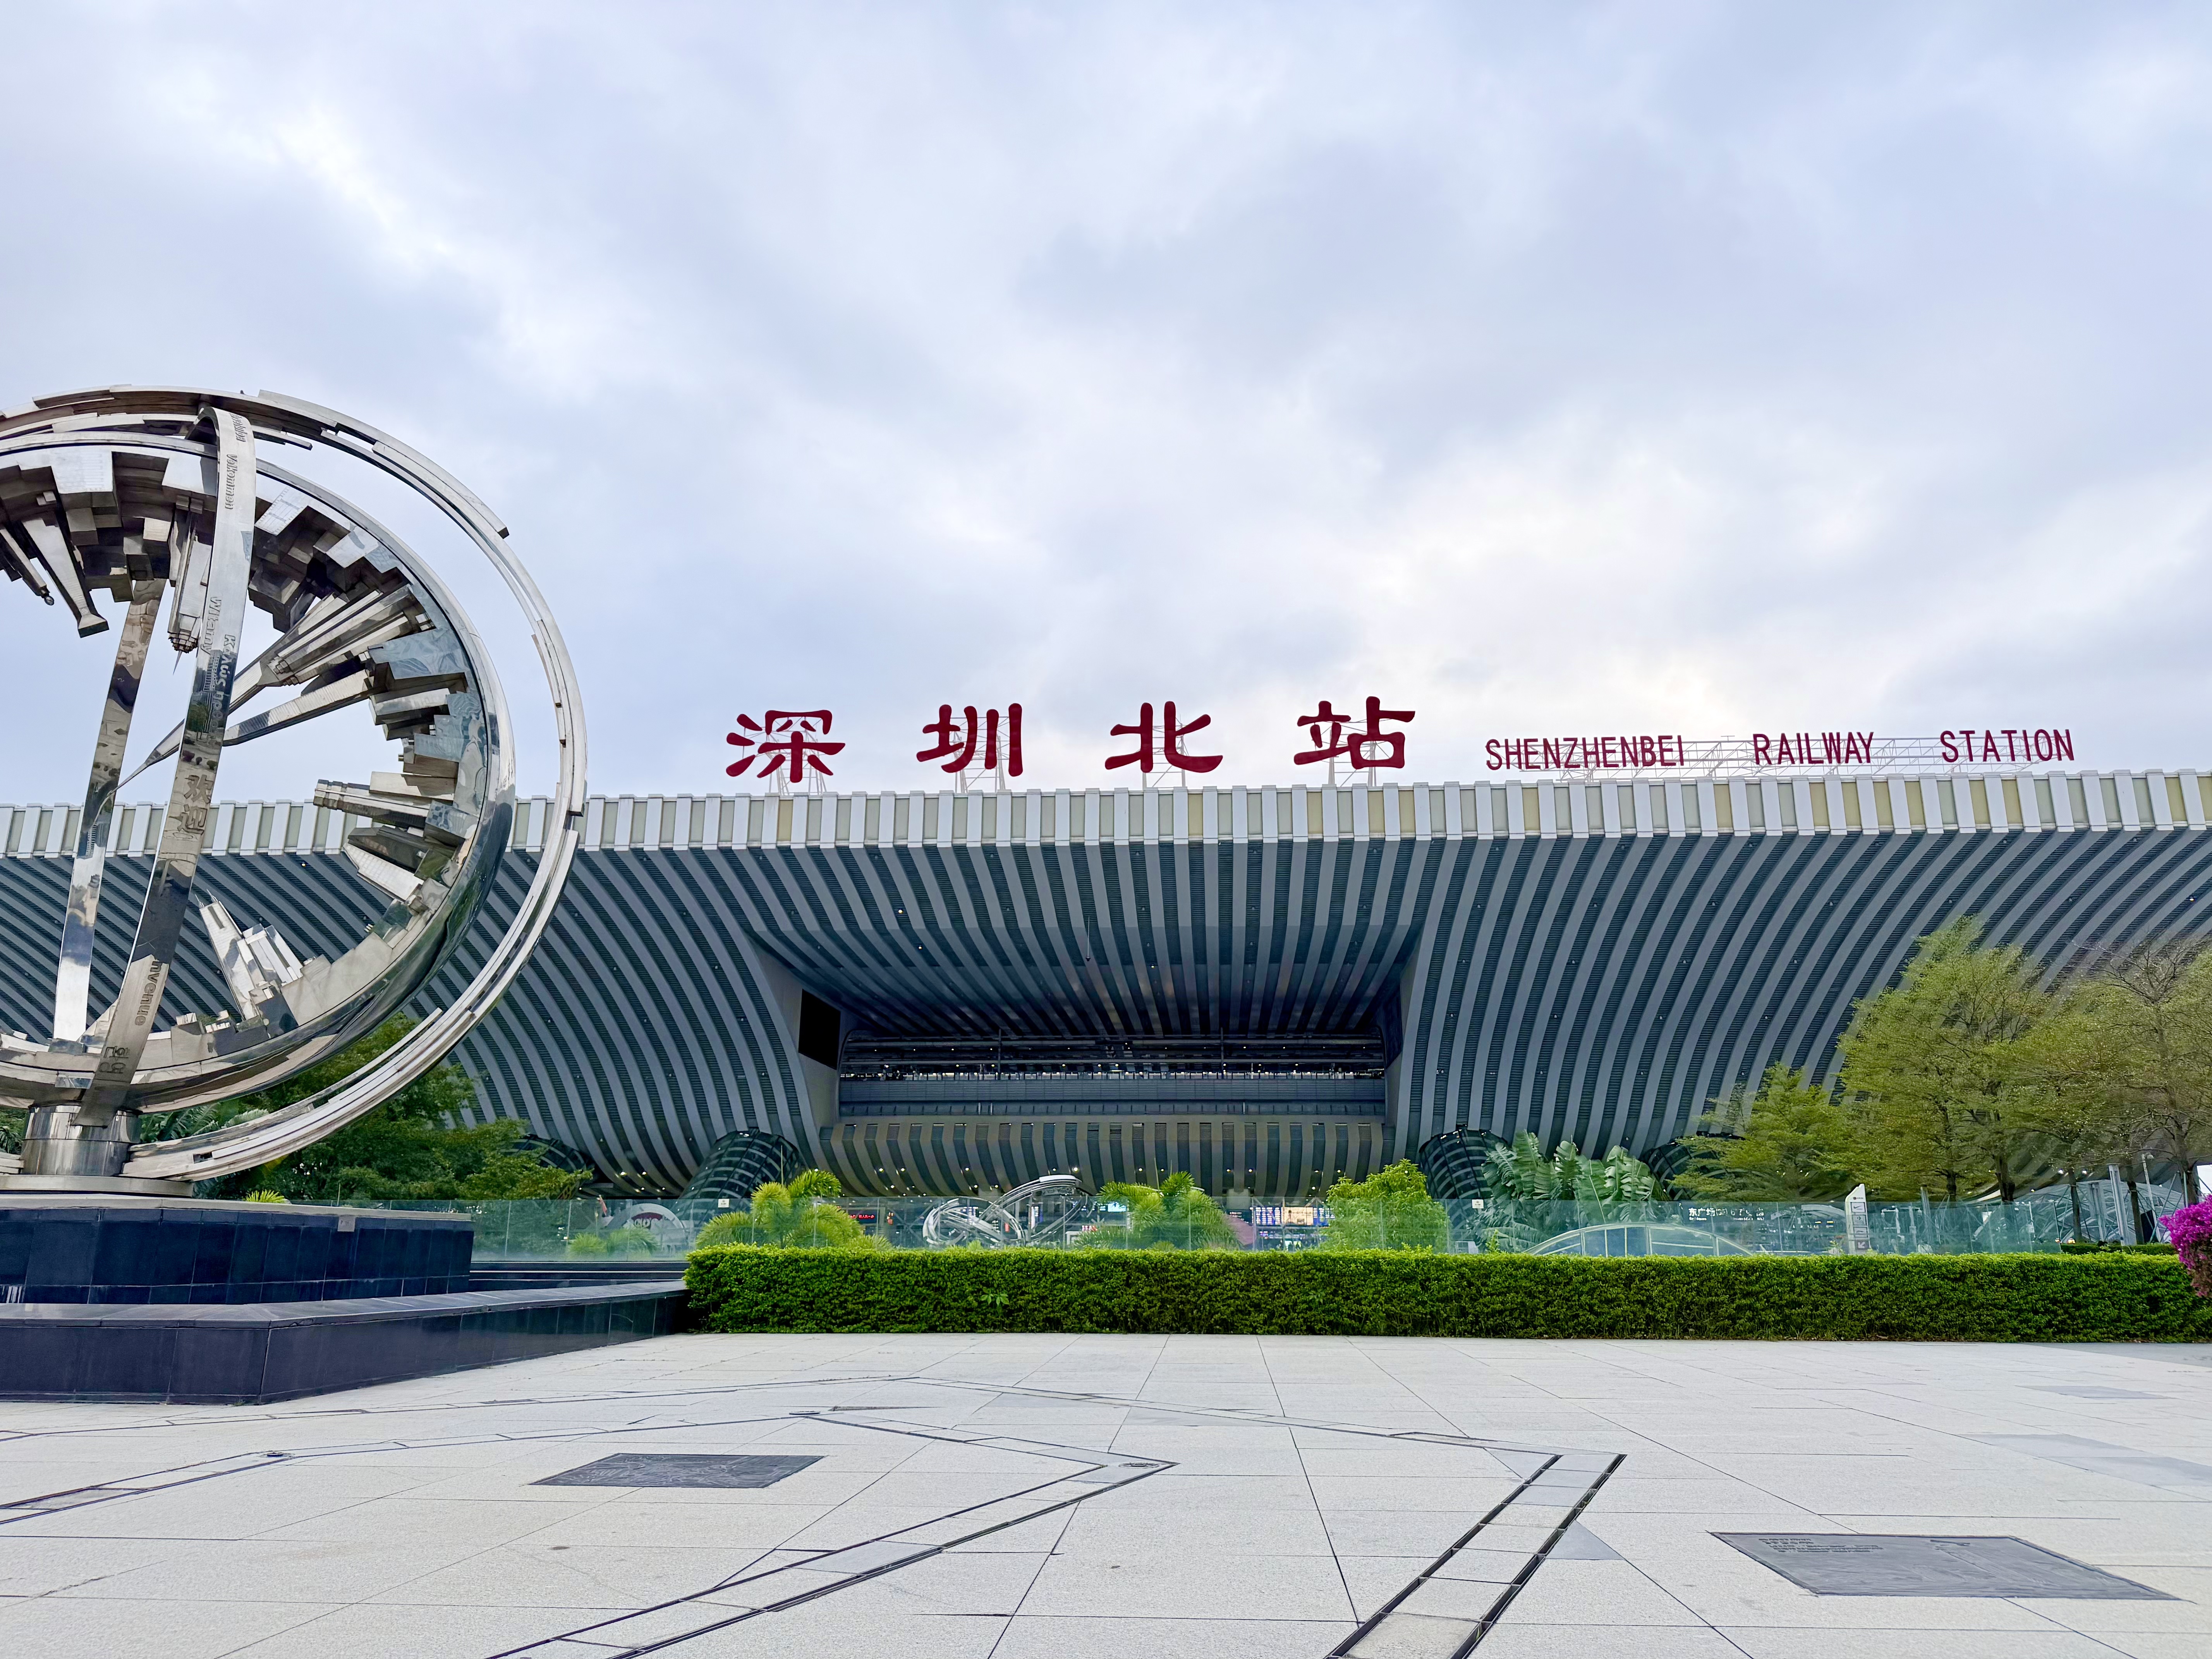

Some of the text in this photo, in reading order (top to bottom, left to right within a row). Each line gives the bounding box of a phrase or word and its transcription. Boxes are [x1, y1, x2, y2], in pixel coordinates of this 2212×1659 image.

[201, 596, 222, 655] Witamy
[726, 697, 1415, 783] 深圳北站
[1486, 730, 2074, 770] SHENZHENBEI RAILWAY STATION
[177, 774, 214, 835] 欢迎
